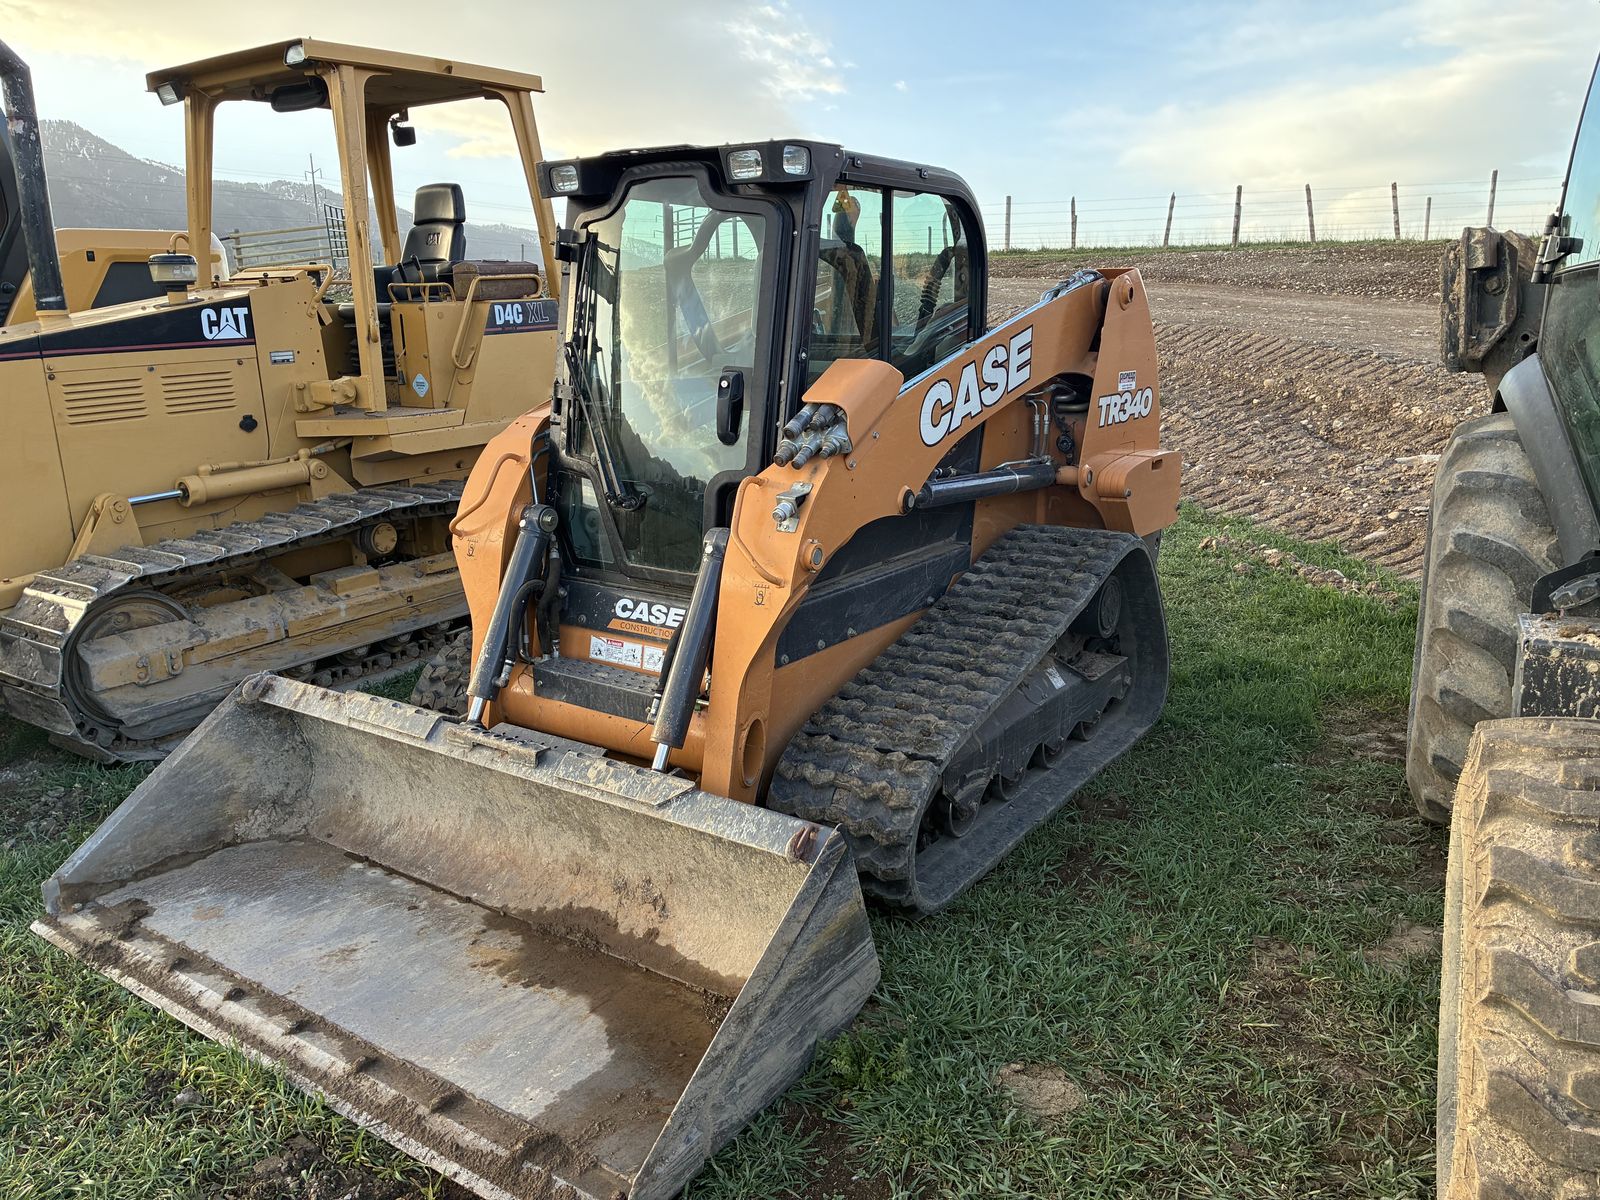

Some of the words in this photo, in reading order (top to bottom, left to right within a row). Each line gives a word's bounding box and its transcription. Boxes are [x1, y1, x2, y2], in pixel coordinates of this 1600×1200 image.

[426, 232, 442, 246] CAT
[201, 307, 249, 340] CAT
[494, 303, 523, 325] D4C
[526, 302, 550, 324] XL
[919, 324, 1034, 447] CASE
[1098, 387, 1153, 428] TR340
[615, 598, 686, 627] CASE
